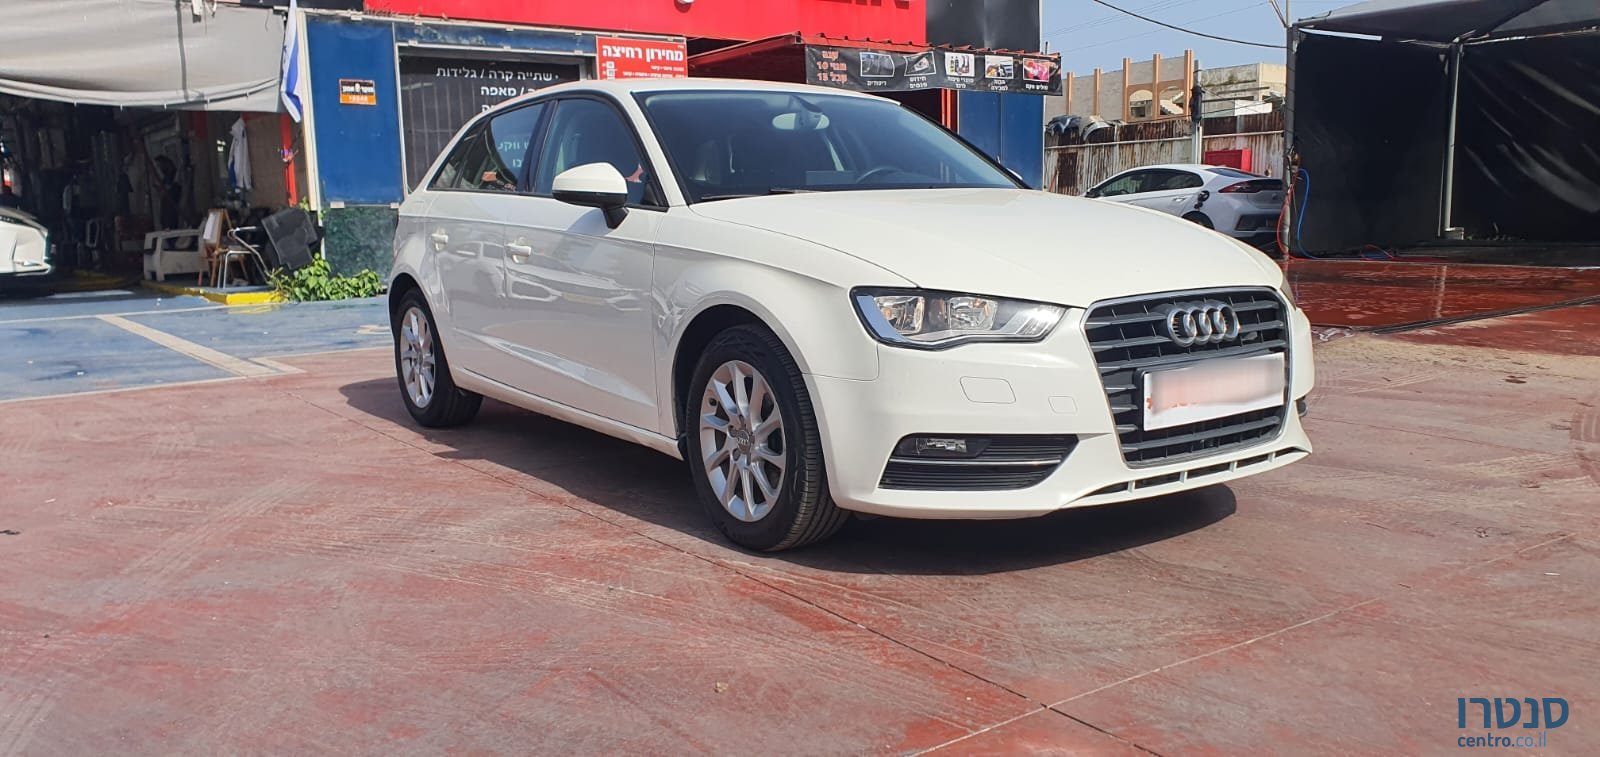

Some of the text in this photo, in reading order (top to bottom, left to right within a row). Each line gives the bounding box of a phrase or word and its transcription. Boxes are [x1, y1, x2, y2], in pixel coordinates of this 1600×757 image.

[602, 45, 684, 63] מחירון רחיצה
[816, 61, 829, 70] 10
[436, 67, 477, 79] גלידות
[488, 70, 514, 82] קרה
[517, 71, 552, 82] שתייה
[817, 71, 848, 84] קבל 15
[480, 86, 517, 97] מאפה
